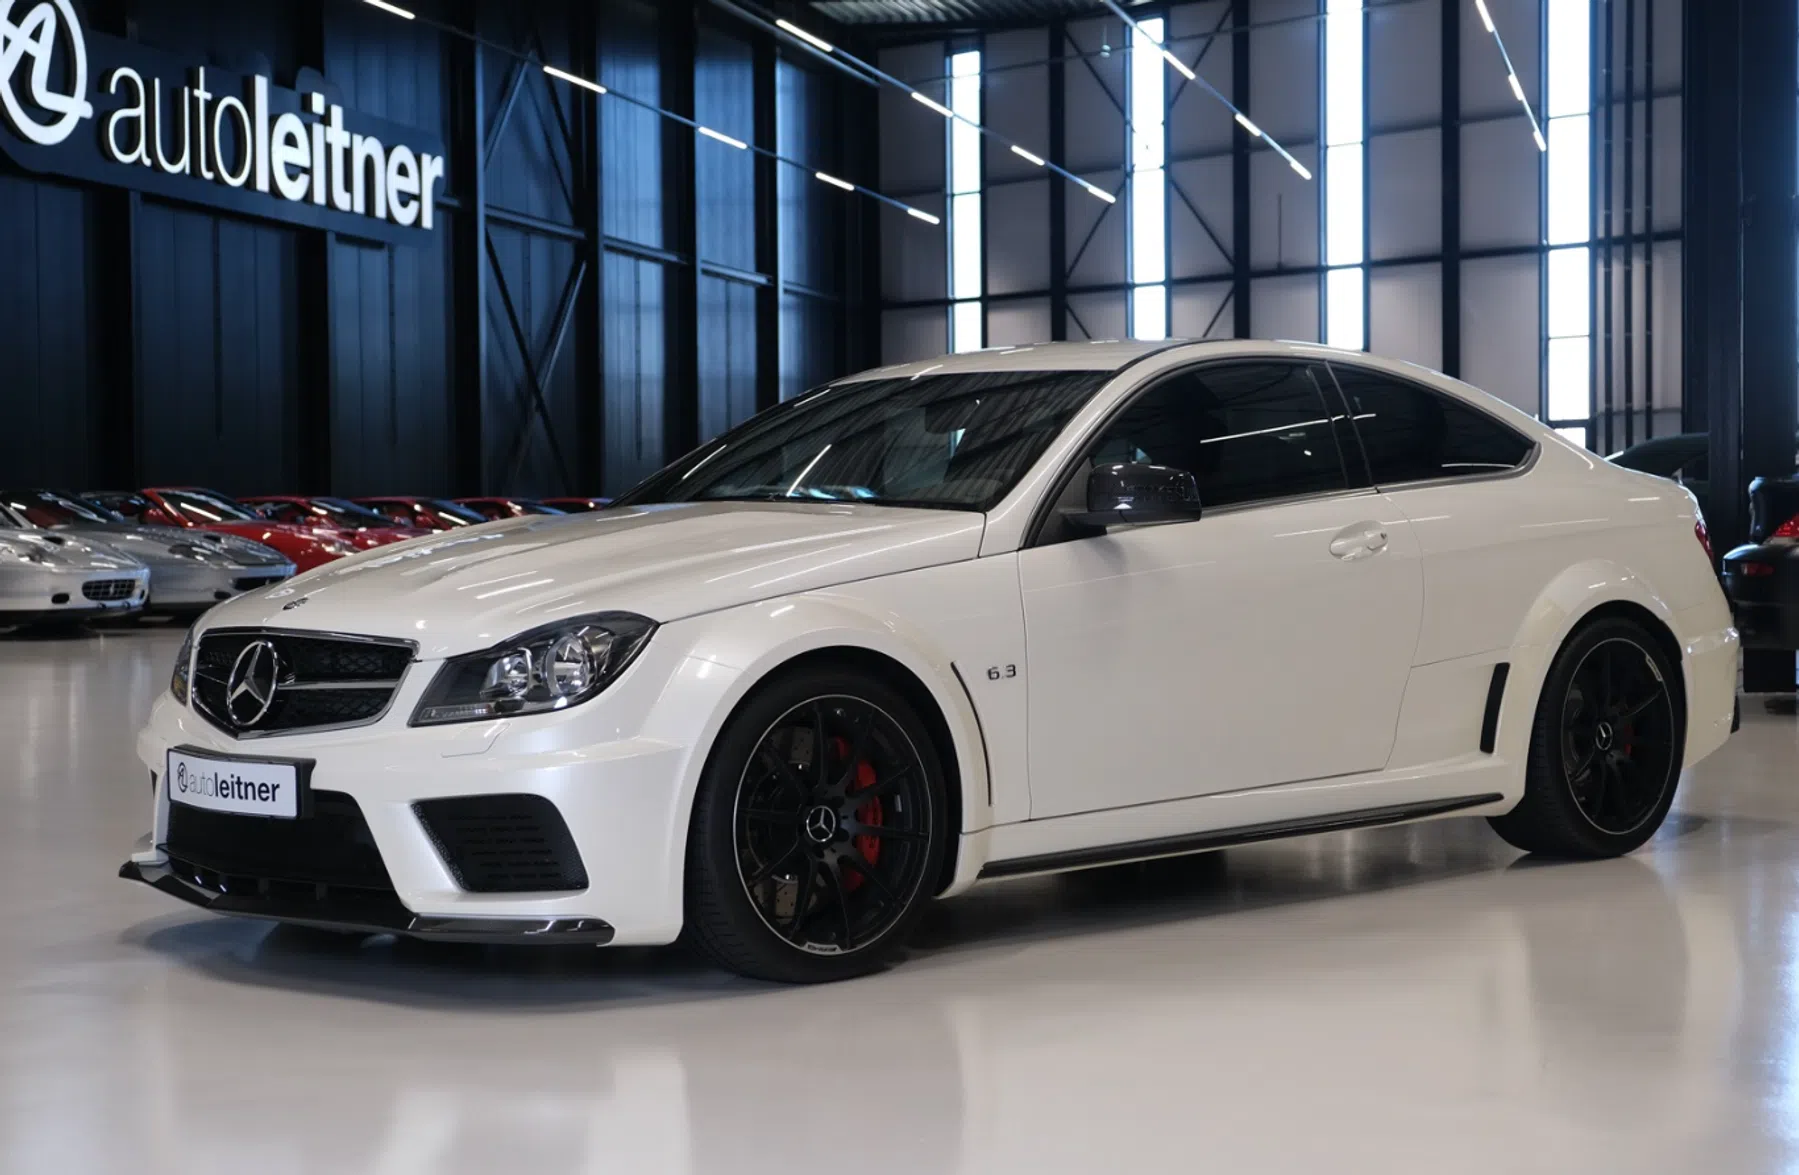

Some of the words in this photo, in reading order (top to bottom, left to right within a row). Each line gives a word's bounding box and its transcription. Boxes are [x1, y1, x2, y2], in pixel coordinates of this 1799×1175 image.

[108, 66, 444, 230] autoleitner
[987, 664, 1016, 680] 6.3
[189, 772, 280, 802] autoleitner
